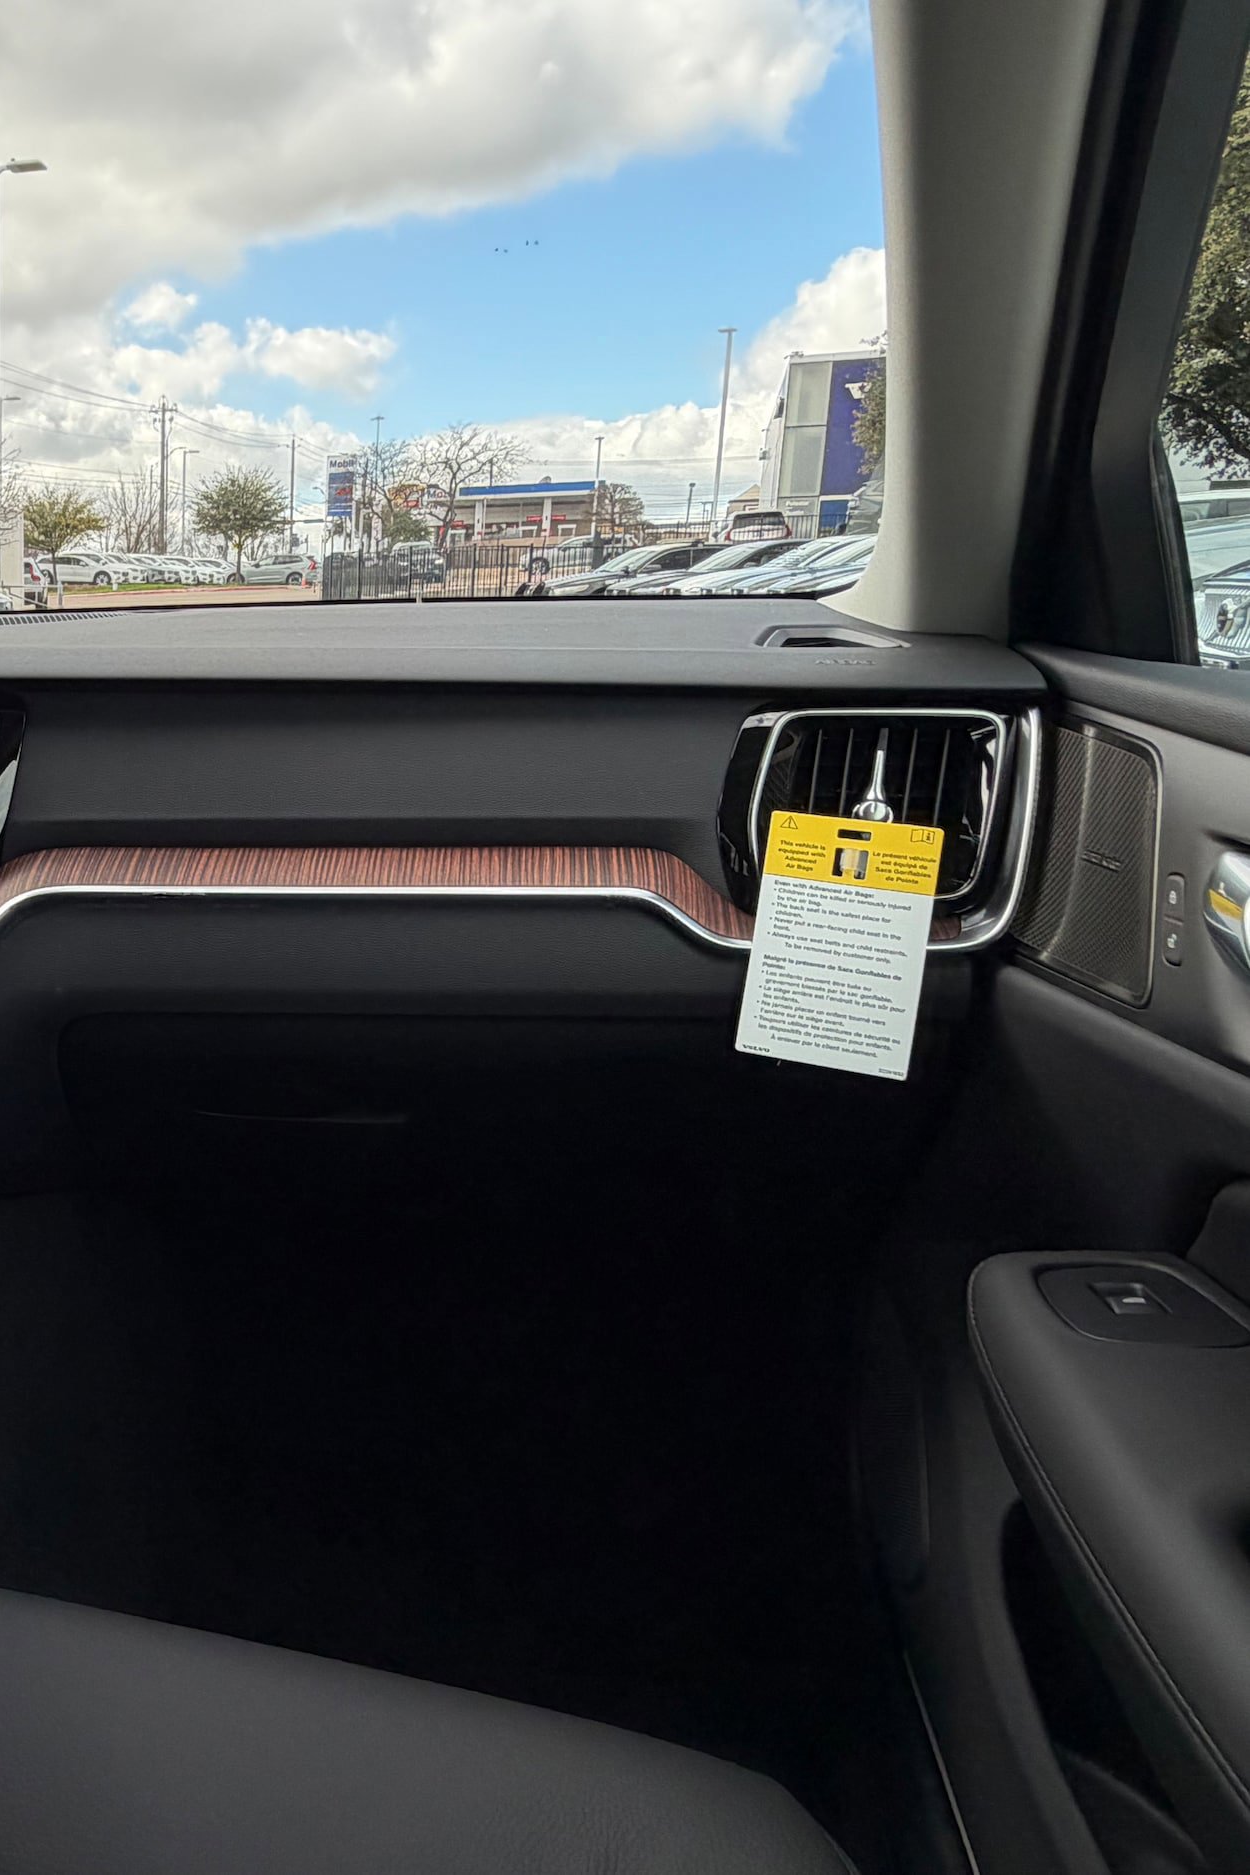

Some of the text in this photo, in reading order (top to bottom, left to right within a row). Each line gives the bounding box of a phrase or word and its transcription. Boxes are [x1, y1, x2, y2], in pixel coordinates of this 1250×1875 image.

[784, 855, 816, 864] Advanced
[808, 884, 842, 894] Advanced
[778, 887, 805, 896] Children
[857, 899, 886, 908] seriously
[812, 923, 848, 933] rear-facing
[771, 931, 794, 939] Always
[803, 946, 832, 954] removed
[842, 952, 874, 960] customer
[778, 972, 802, 980] enfants
[771, 1002, 793, 1010] jamais
[812, 1033, 846, 1042] protection
